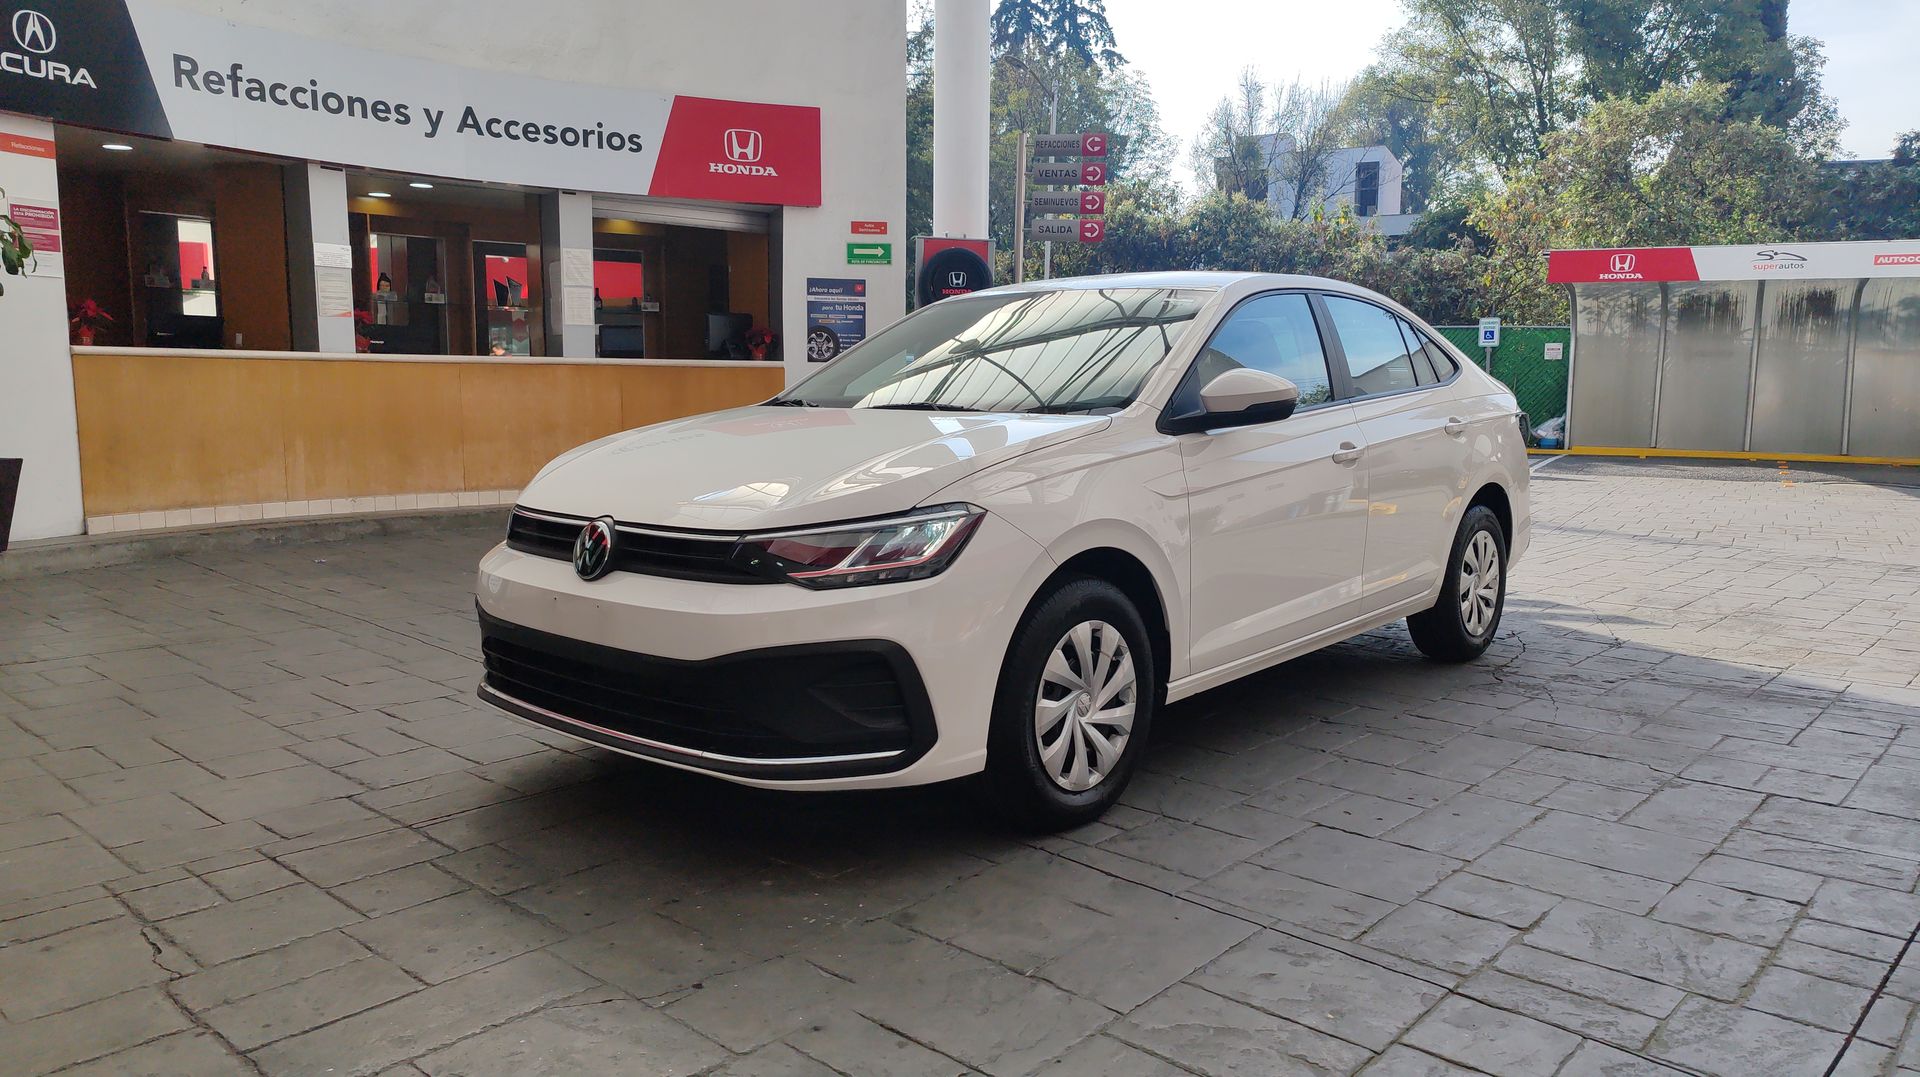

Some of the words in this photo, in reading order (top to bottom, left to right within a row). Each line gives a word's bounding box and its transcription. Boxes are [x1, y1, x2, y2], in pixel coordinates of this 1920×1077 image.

[0, 51, 98, 89] CURA
[172, 53, 411, 126] Refacciones
[423, 107, 445, 139] y
[456, 105, 644, 154] Accesorios
[1035, 140, 1080, 149] REFACCIONES
[709, 163, 778, 177] HONDA
[1038, 169, 1078, 178] VENTAS
[1034, 197, 1079, 206] SEMINUEVOS
[1038, 225, 1073, 234] SALIDA
[1752, 262, 1805, 271] superautos
[1598, 272, 1643, 280] HONDA
